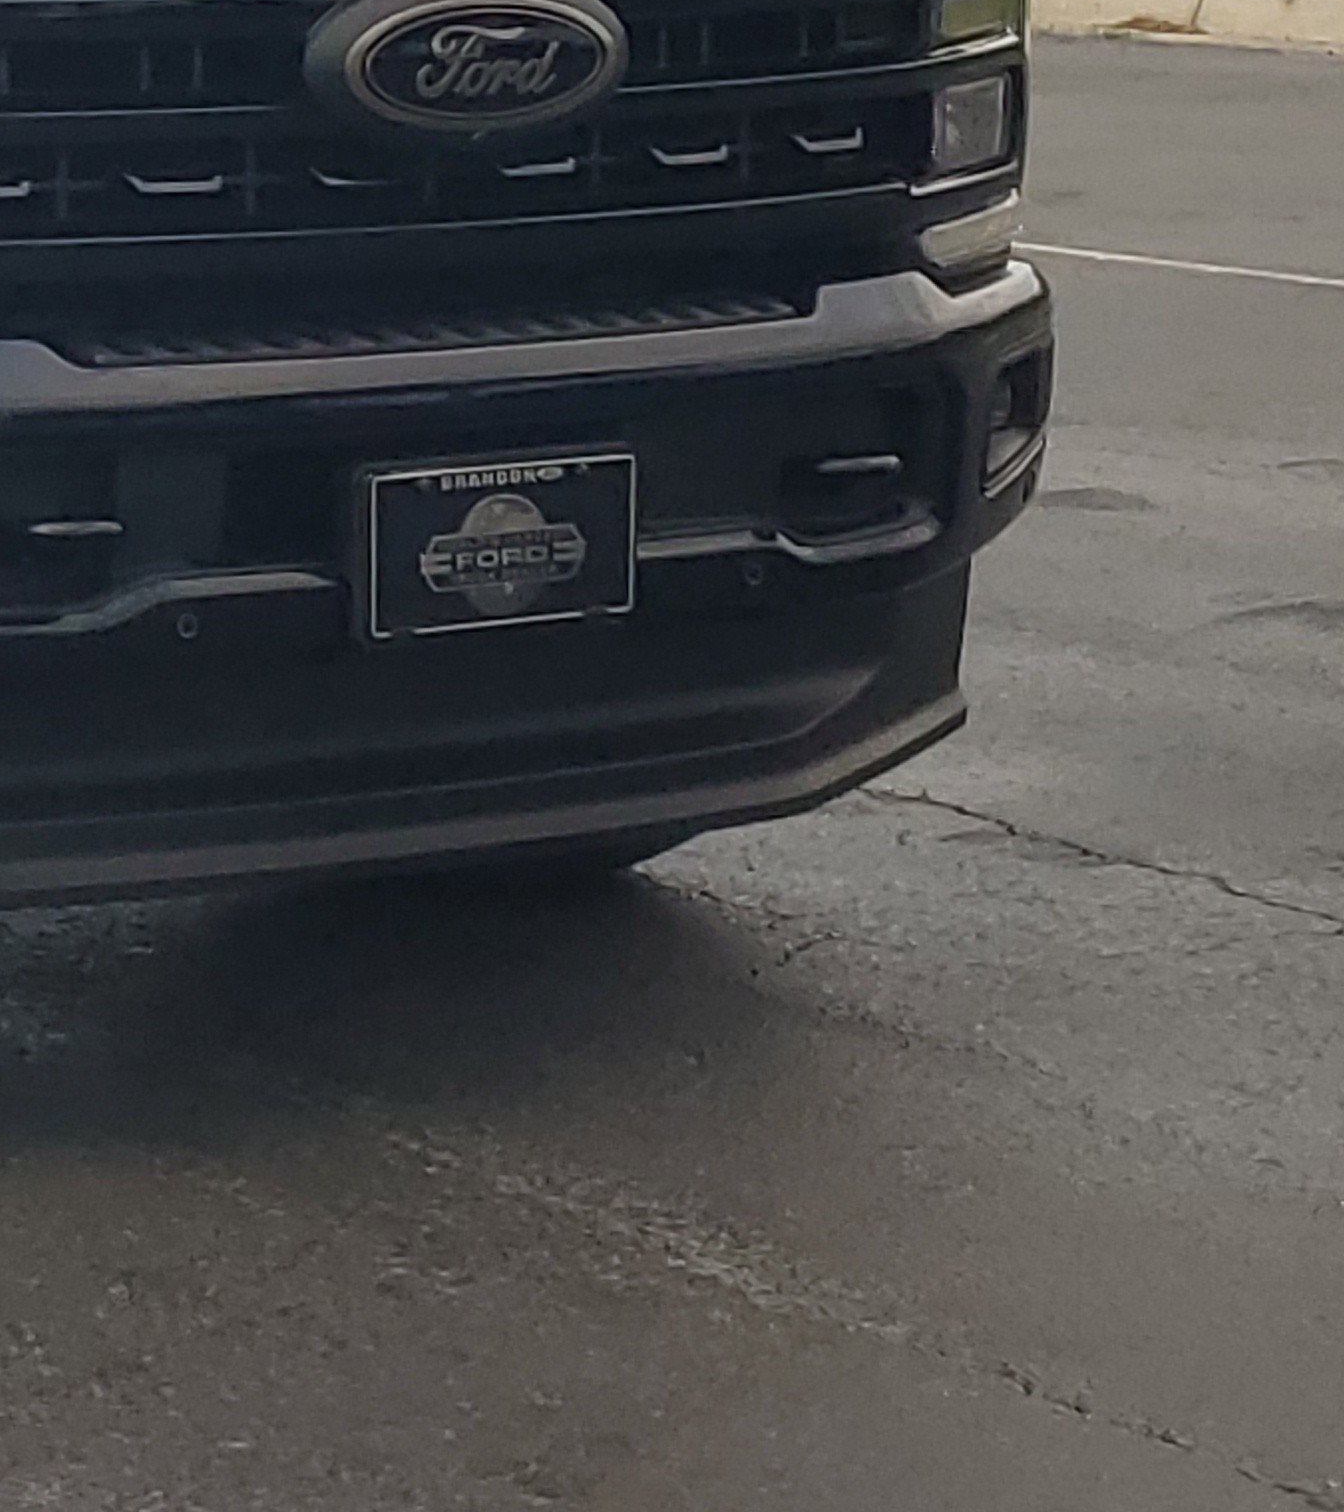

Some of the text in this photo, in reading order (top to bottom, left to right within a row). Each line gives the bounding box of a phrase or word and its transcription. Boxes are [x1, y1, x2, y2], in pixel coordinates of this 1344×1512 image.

[415, 22, 562, 98] Ford
[440, 468, 538, 491] BRANDON
[455, 544, 550, 572] FORD
